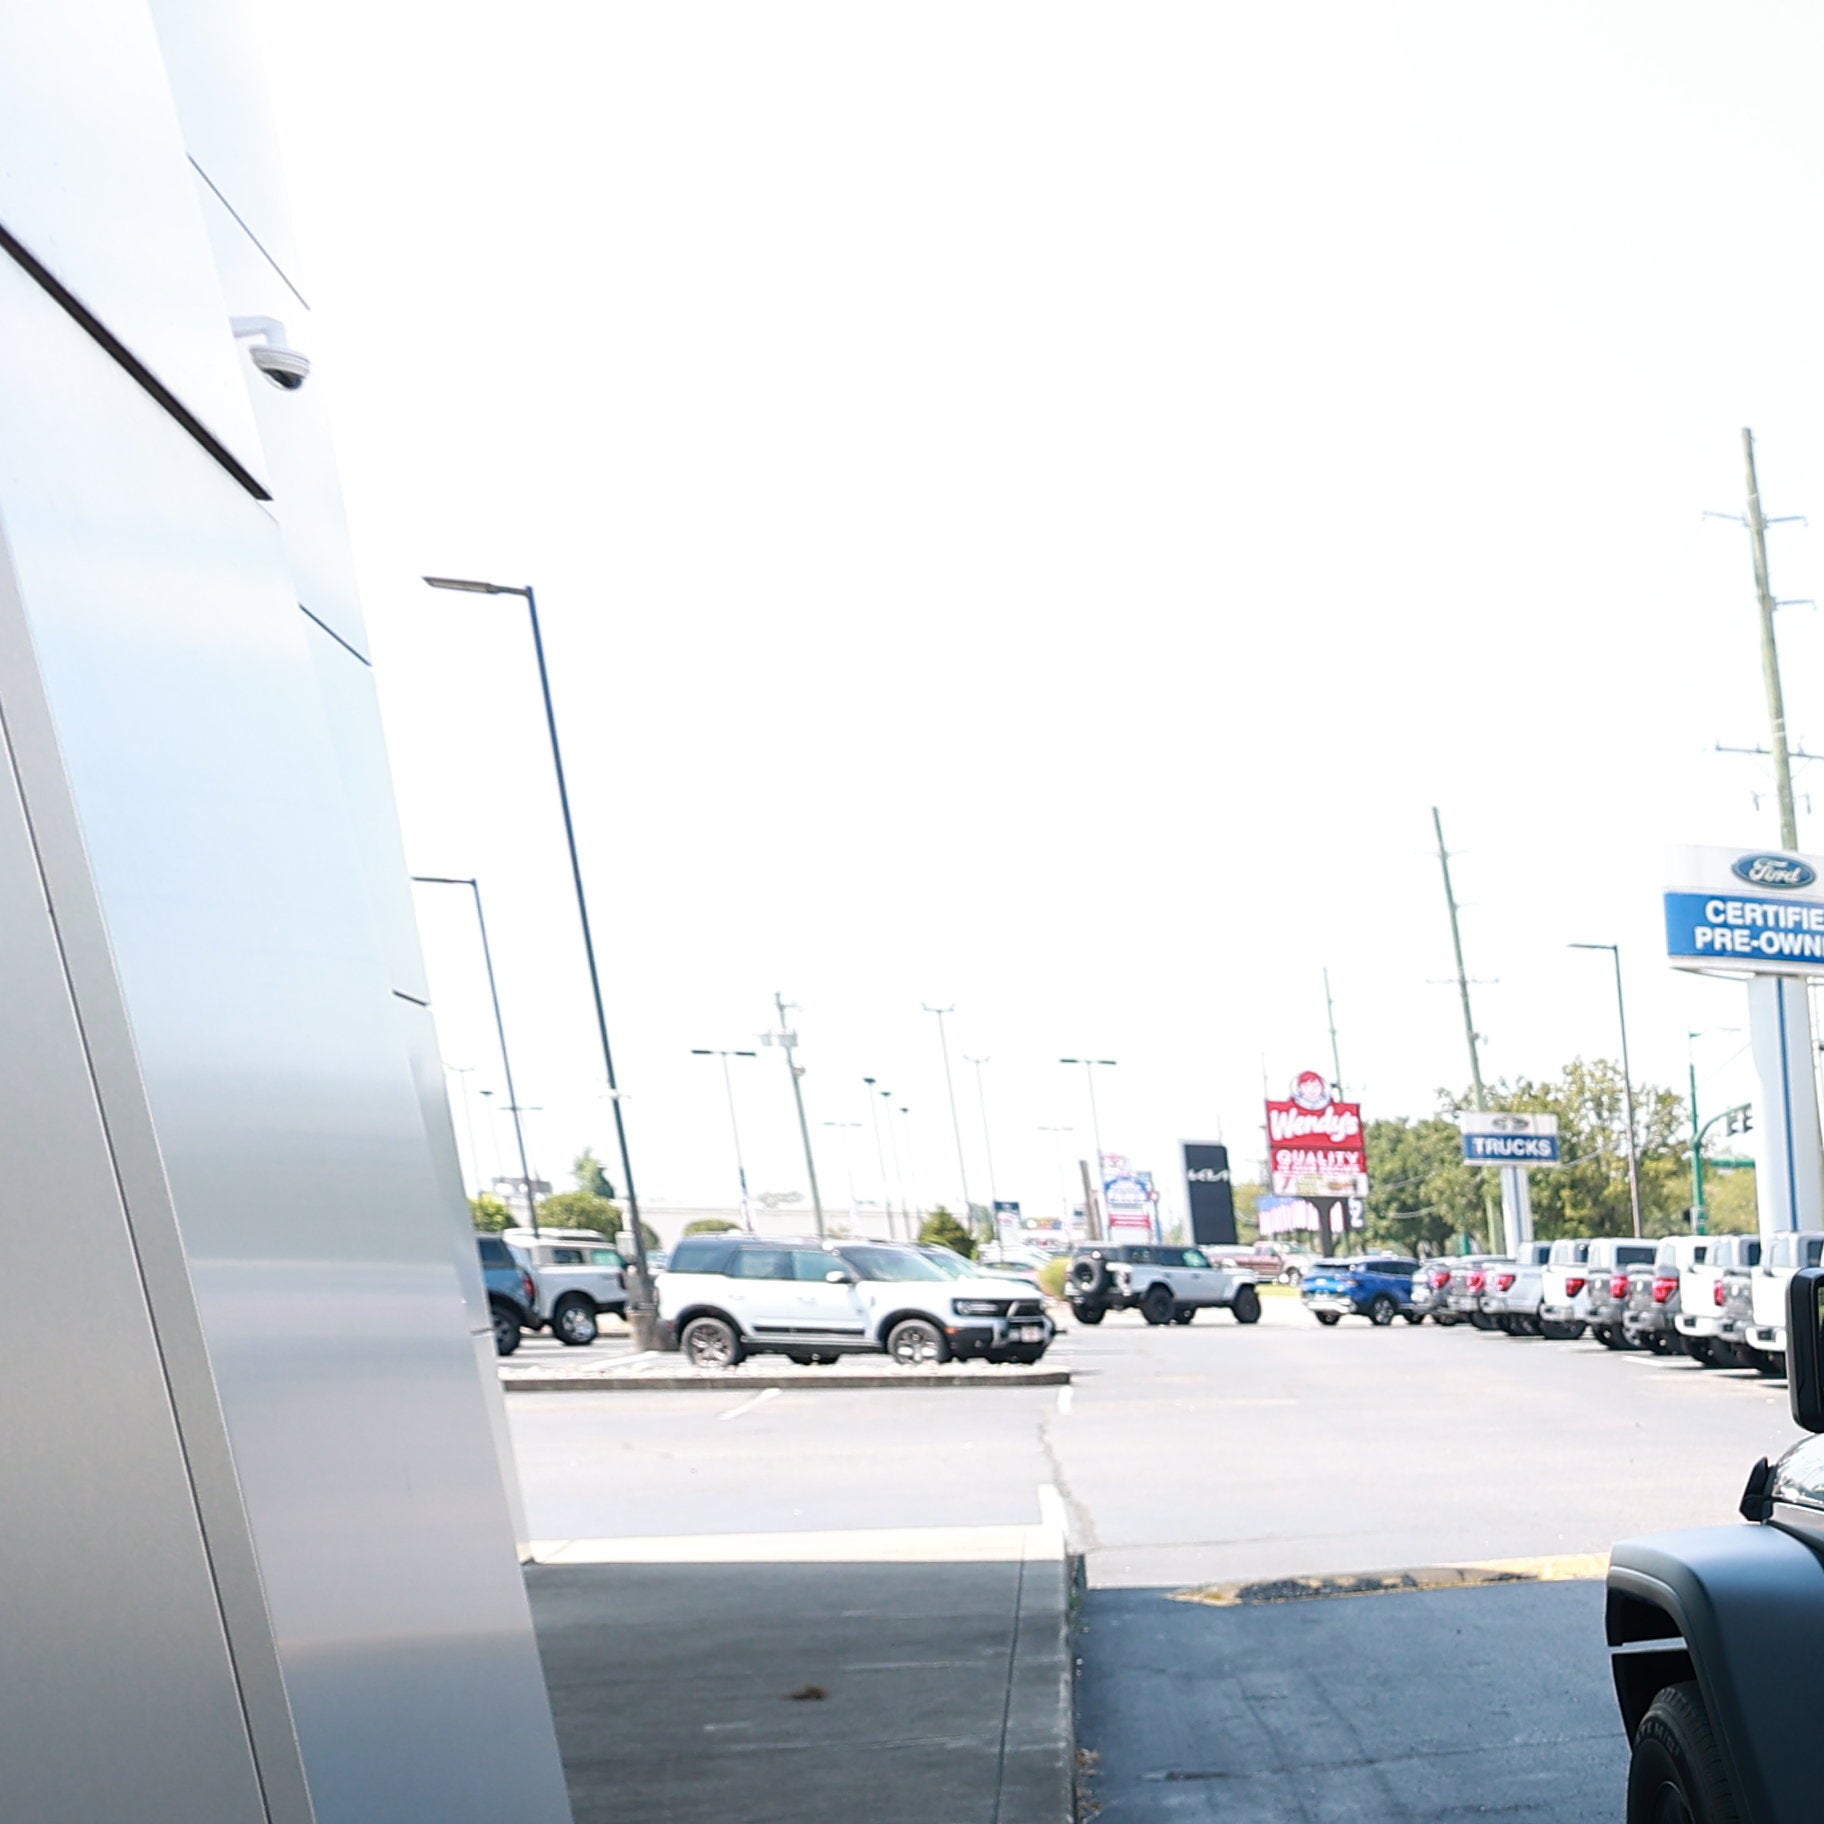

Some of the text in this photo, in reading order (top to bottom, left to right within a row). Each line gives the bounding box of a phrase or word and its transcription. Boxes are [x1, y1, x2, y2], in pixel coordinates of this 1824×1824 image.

[1749, 858, 1801, 884] Ford
[1269, 1105, 1359, 1142] Wendy's
[1276, 1149, 1359, 1166] QUALITY
[1473, 1138, 1551, 1157] TRUCKS
